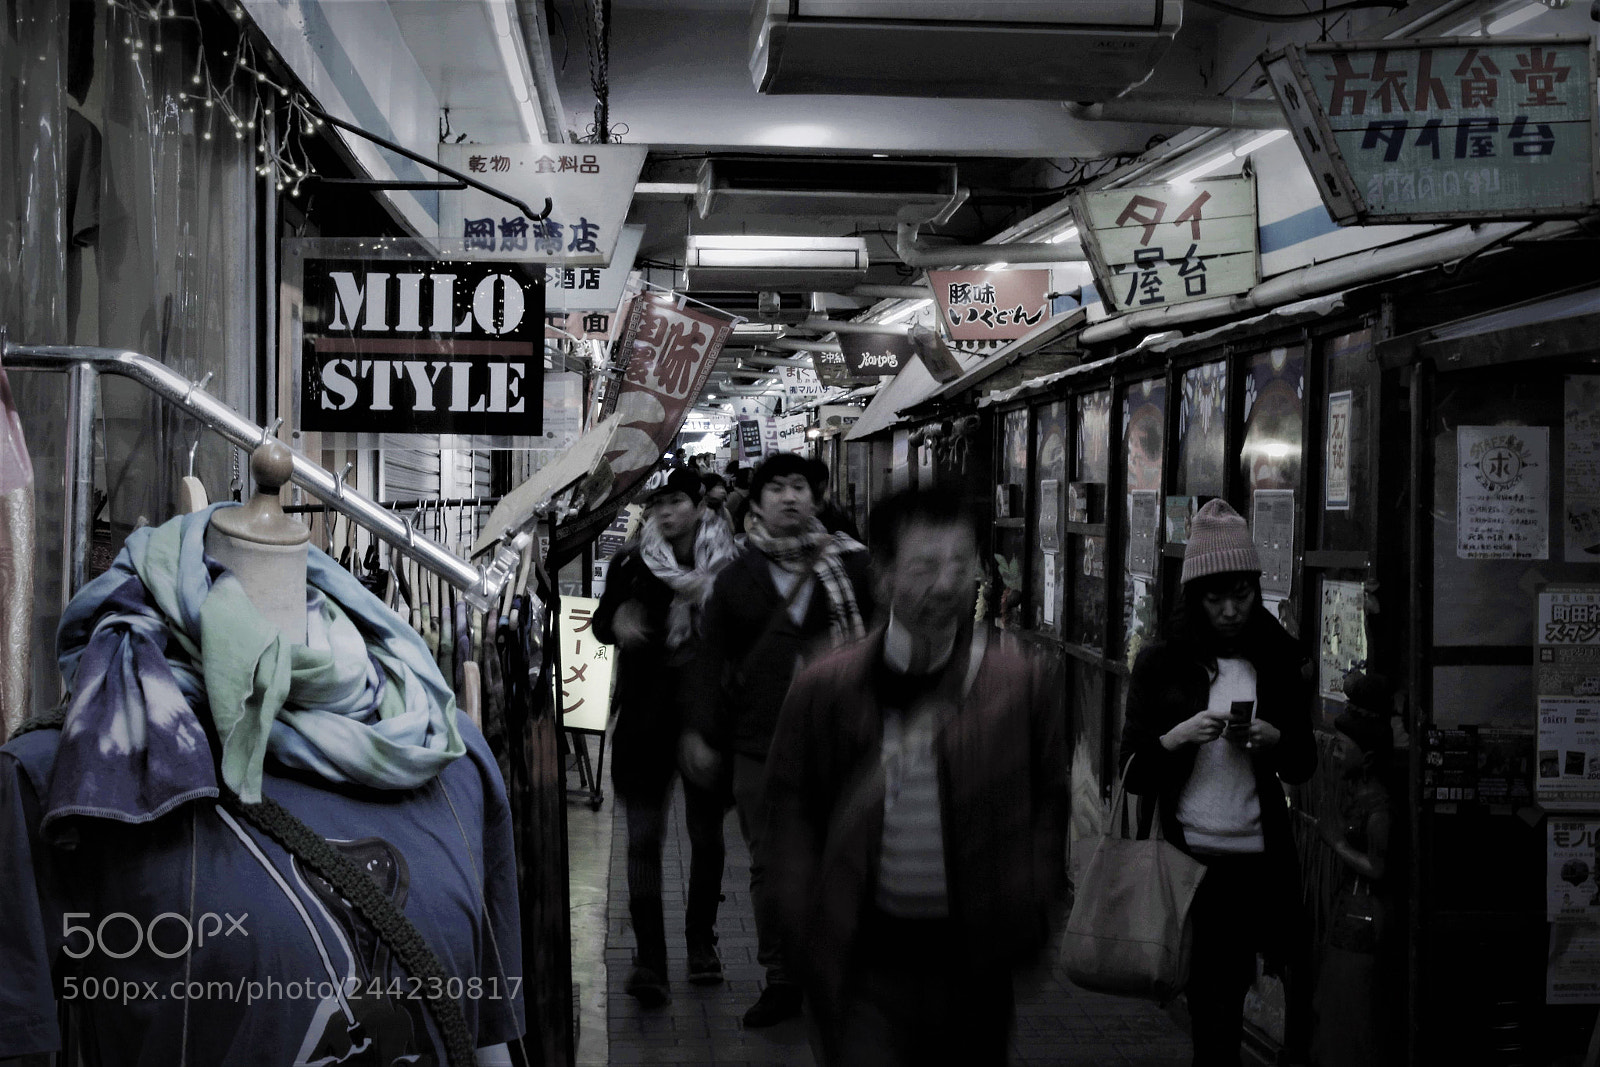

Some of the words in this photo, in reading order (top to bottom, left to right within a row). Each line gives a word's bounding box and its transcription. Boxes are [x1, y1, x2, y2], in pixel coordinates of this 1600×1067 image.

[1361, 116, 1555, 161] タイ屋台
[1115, 190, 1212, 246] タイ
[328, 271, 525, 335] MILO
[949, 282, 996, 305] 豚味
[1125, 243, 1208, 307] 屋台
[321, 358, 526, 413] STYLE
[562, 607, 593, 714] ラーメン
